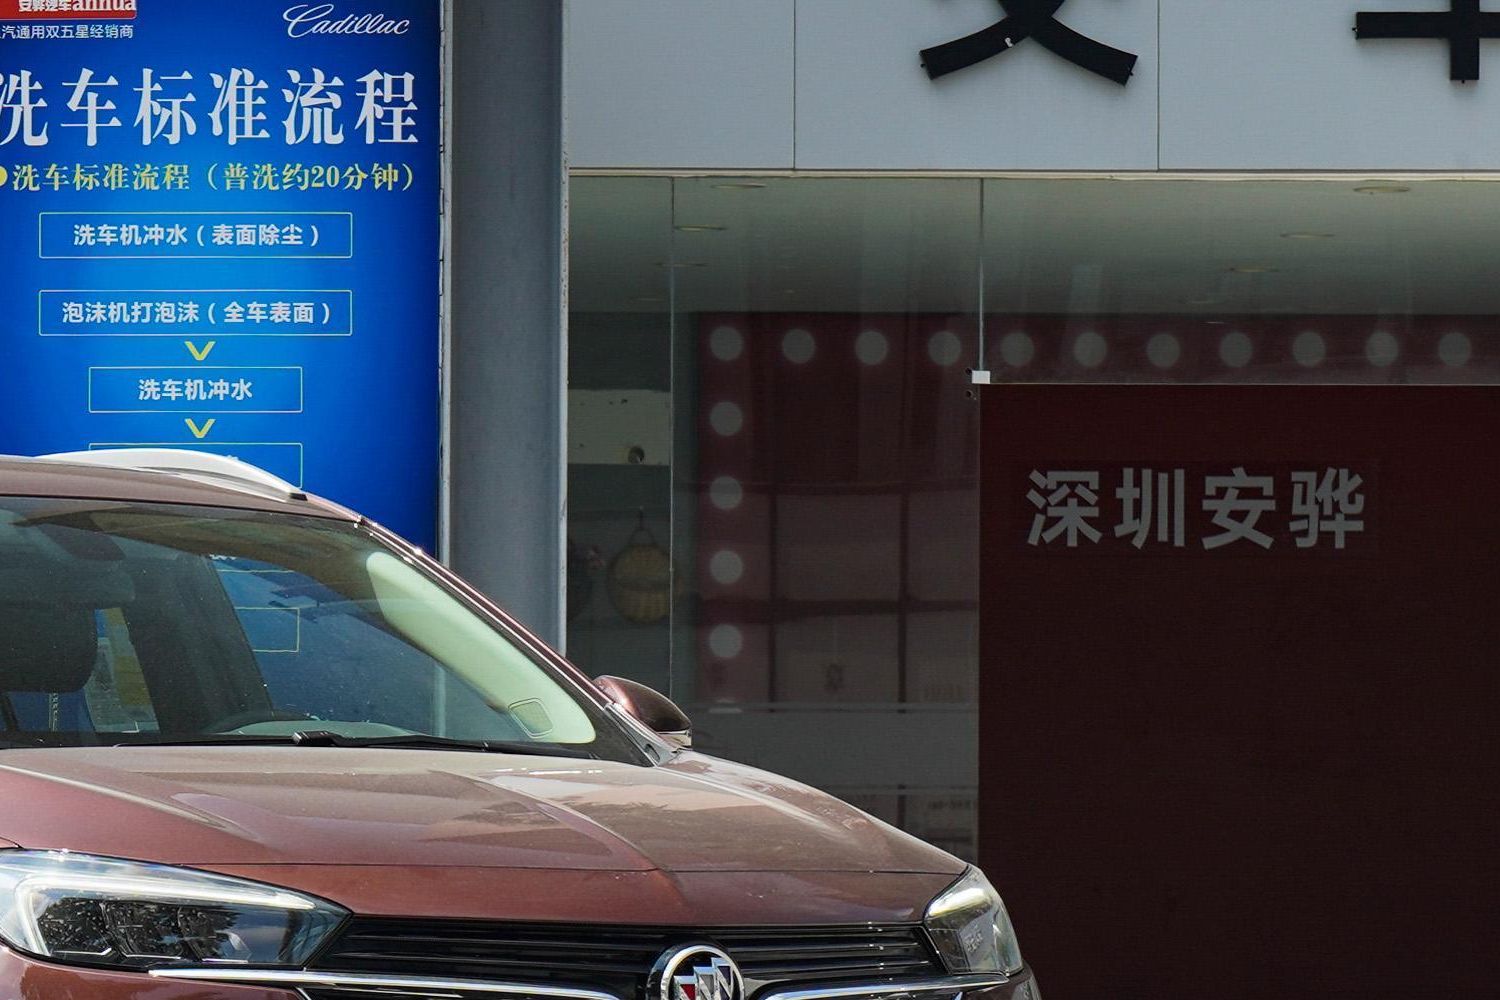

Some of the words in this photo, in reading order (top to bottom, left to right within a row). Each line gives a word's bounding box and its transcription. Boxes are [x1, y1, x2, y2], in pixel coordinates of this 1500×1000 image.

[283, 4, 411, 39] Cadillac
[138, 378, 253, 402] 洗车机冲水
[1026, 467, 1365, 550] 深圳安骅
